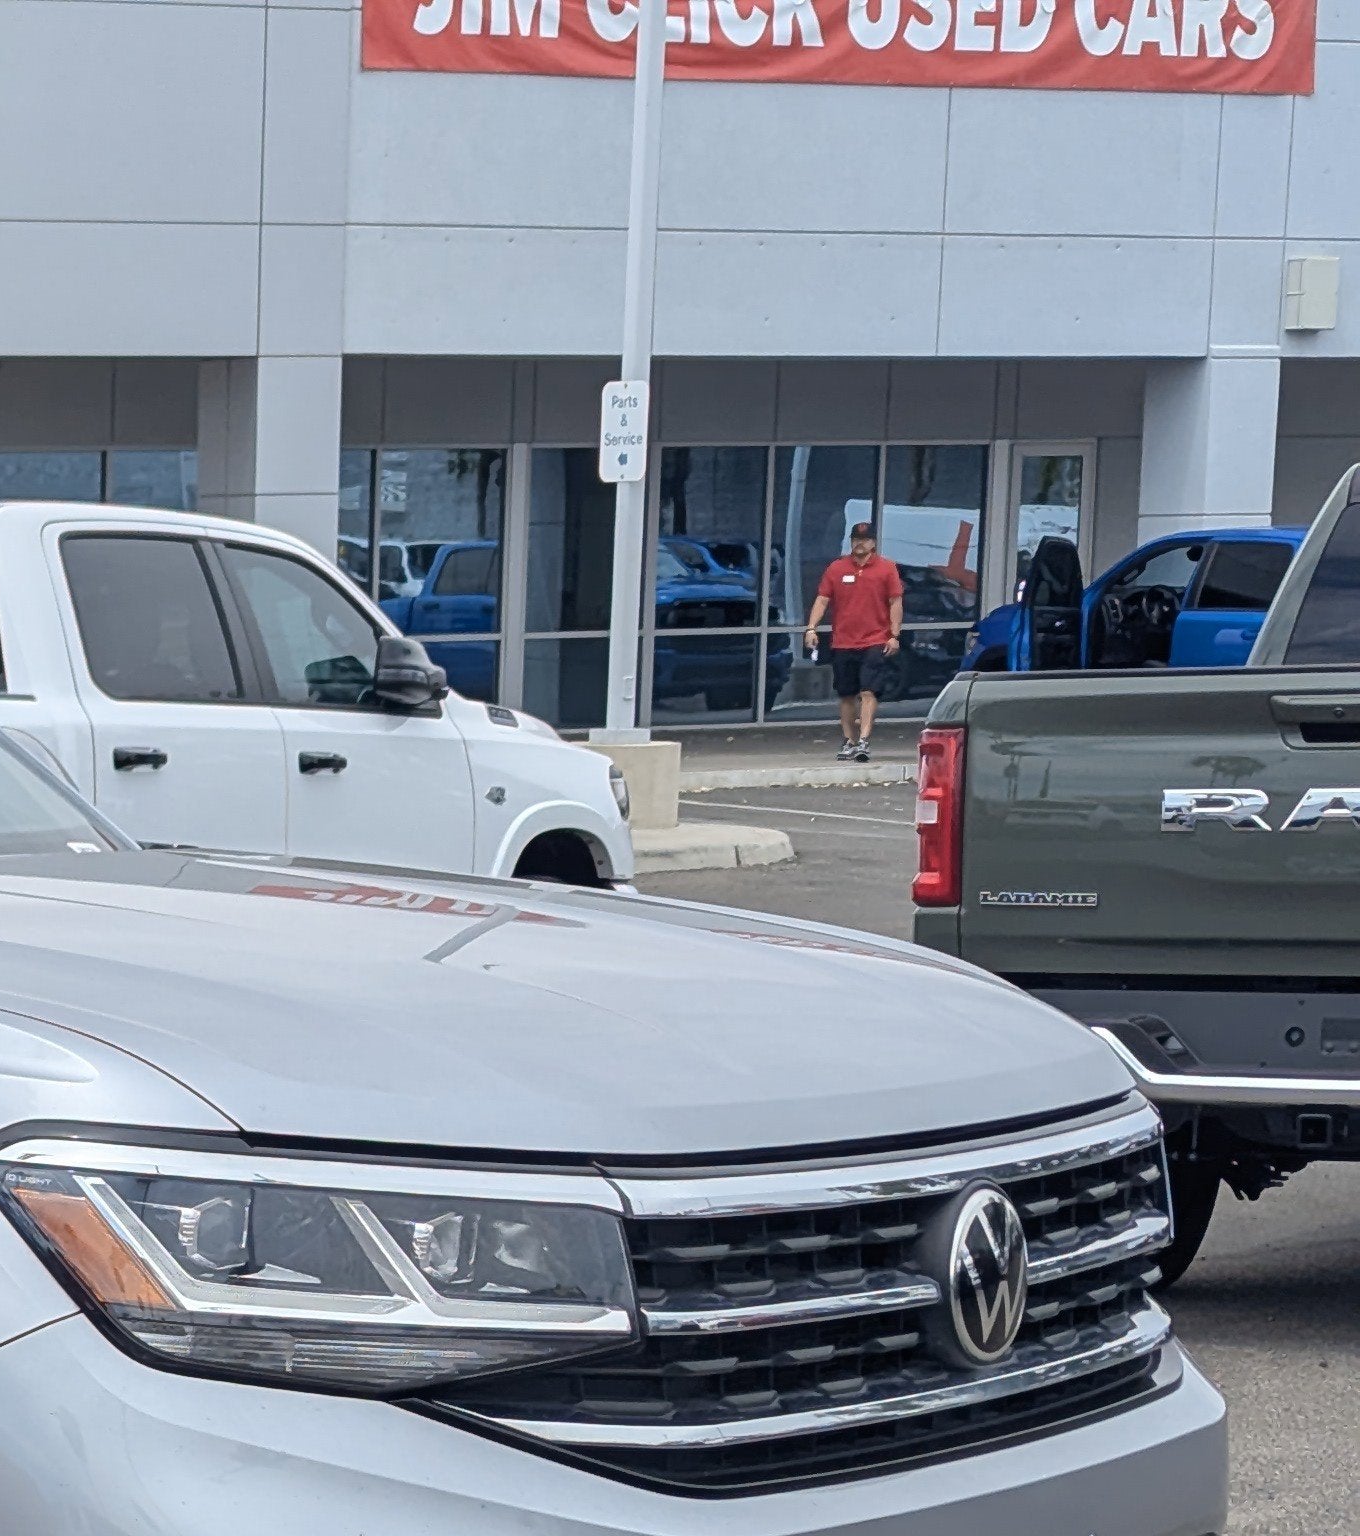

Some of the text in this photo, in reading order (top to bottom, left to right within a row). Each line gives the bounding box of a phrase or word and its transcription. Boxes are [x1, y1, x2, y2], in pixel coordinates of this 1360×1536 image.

[586, 0, 824, 47] CICK
[847, 0, 1055, 52] USED
[1076, 0, 1275, 60] CARS
[611, 395, 638, 408] Parts
[620, 413, 628, 426] &
[604, 431, 643, 446] Service
[979, 891, 1098, 908] LARAMIE
